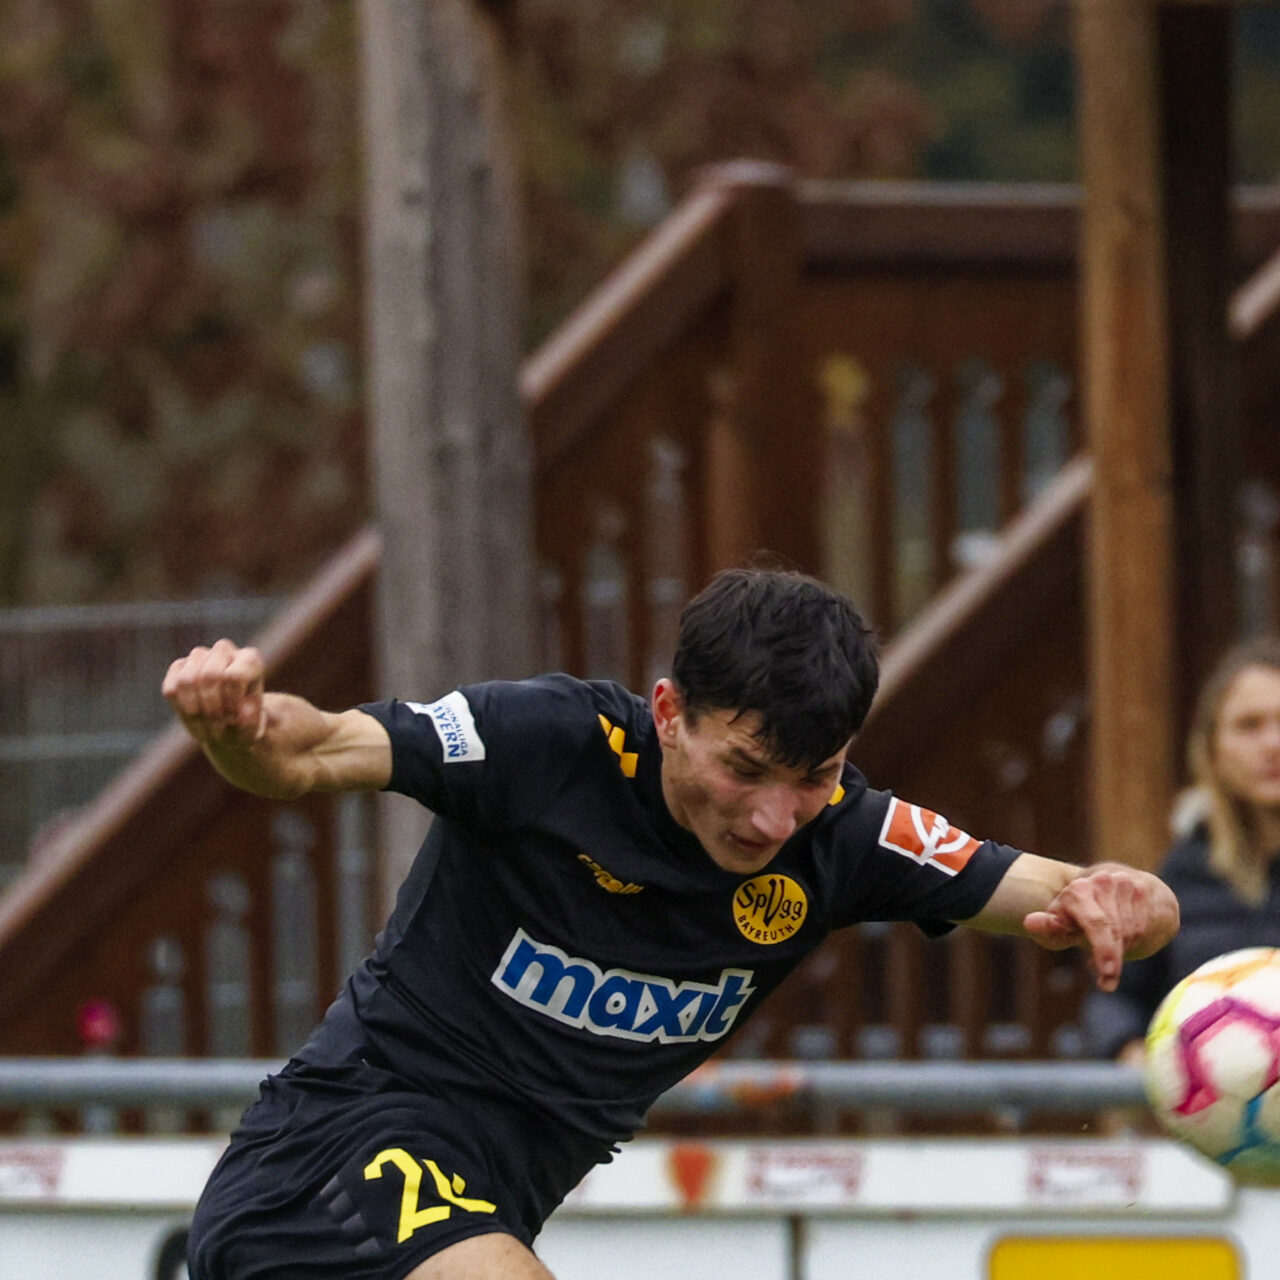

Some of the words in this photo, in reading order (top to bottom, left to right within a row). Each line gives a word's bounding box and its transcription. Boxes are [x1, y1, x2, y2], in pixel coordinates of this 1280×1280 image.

[736, 878, 803, 928] SpVgg
[738, 915, 795, 941] BAYREUTH
[499, 937, 749, 1037] maxit
